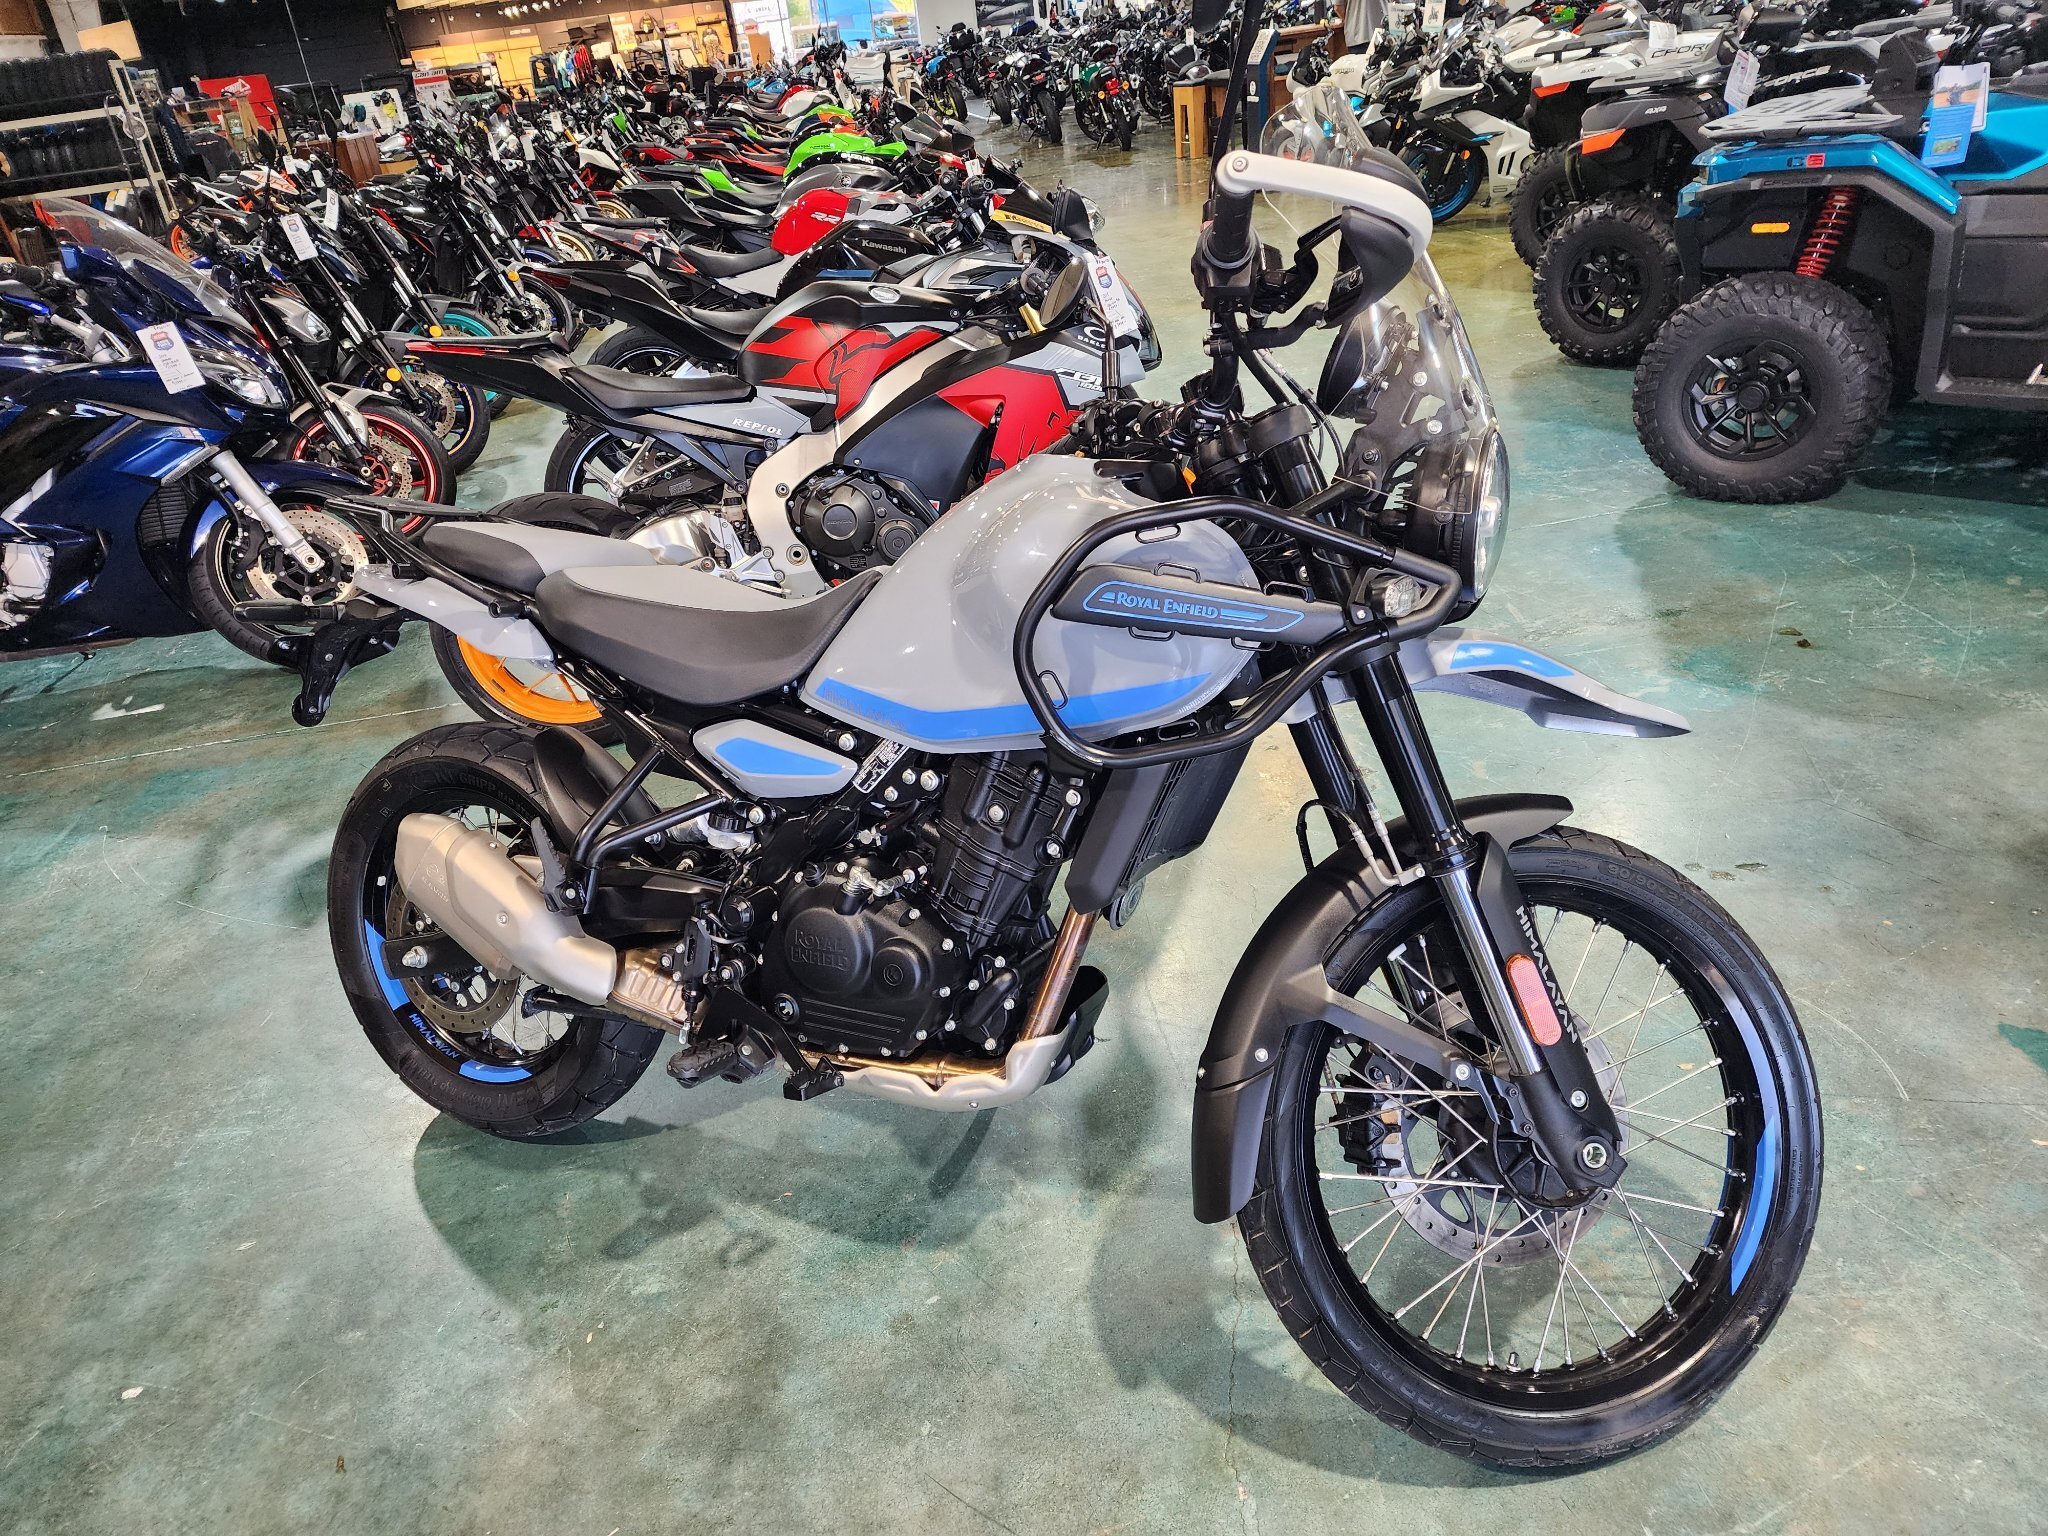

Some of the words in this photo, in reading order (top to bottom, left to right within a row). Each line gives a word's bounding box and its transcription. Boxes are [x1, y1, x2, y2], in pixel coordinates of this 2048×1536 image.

[861, 239, 907, 255] Kawasaki
[1077, 334, 1106, 349] OAKLE
[732, 418, 783, 436] REPSOL
[1117, 591, 1161, 610] ROYAL
[1163, 599, 1218, 618] ENFIELD
[794, 928, 843, 953] ROYAL
[791, 946, 849, 972] ENFIELD
[1516, 905, 1578, 1044] HIMALAYAN
[408, 1013, 460, 1059] HIMALAYAN
